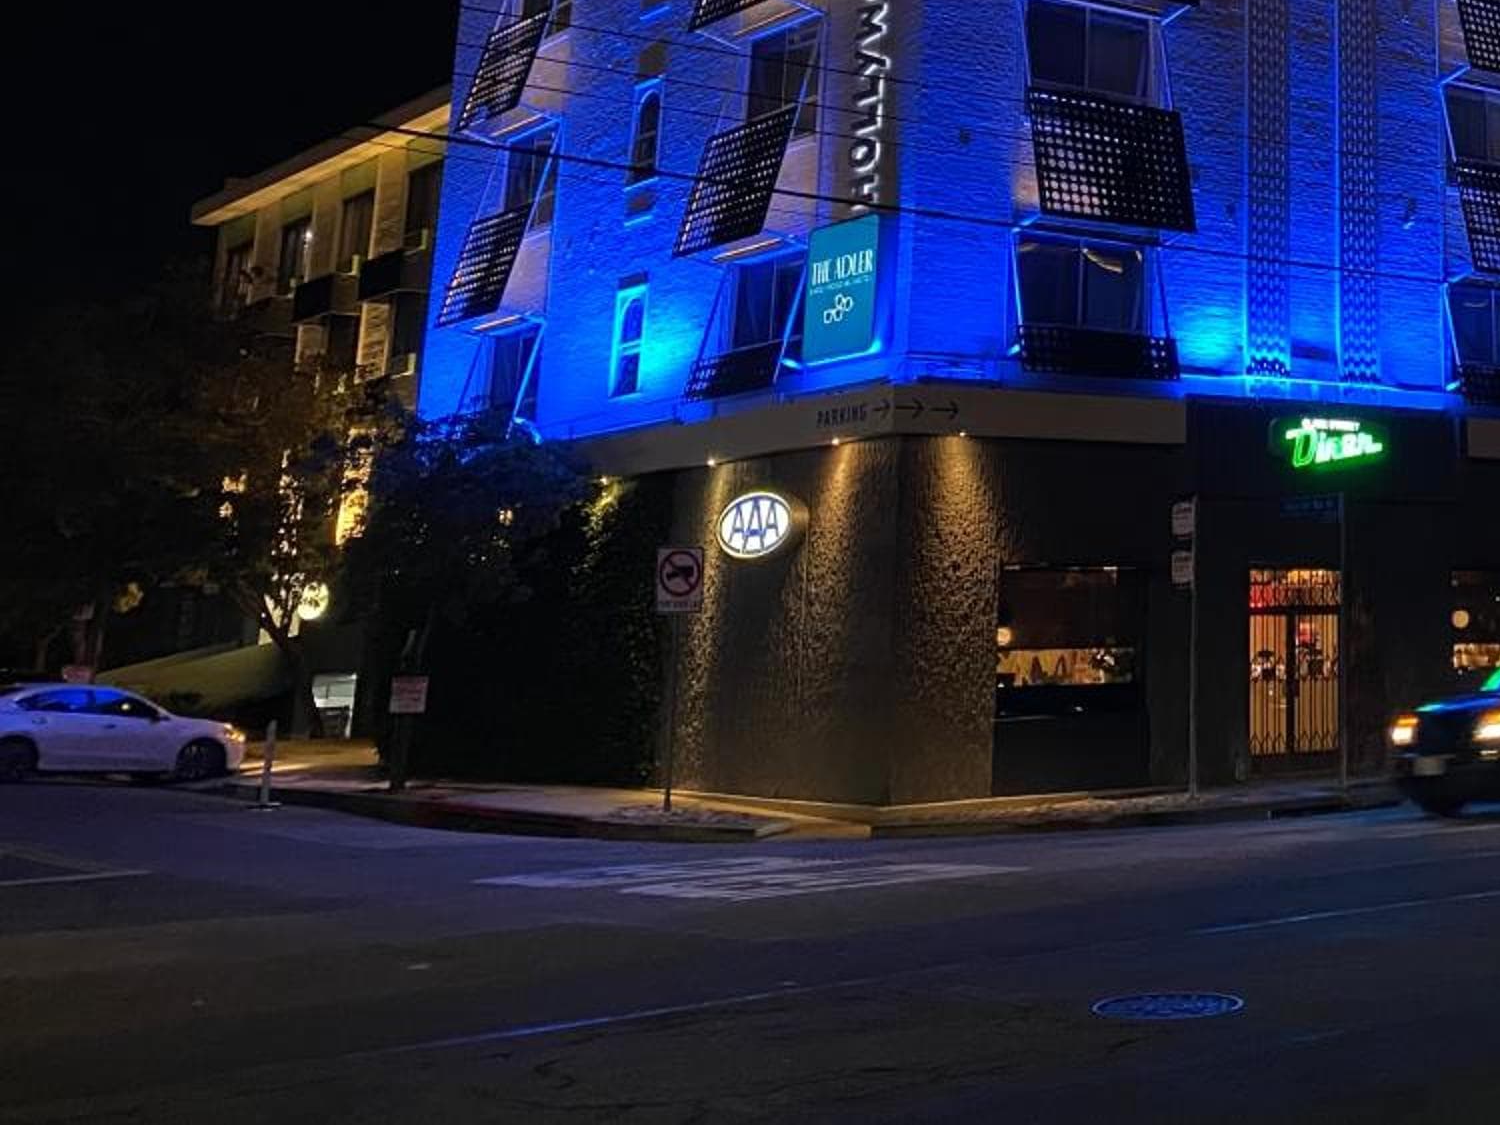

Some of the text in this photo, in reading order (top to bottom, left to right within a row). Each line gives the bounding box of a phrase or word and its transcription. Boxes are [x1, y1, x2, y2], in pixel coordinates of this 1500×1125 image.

[834, 248, 873, 280] ADLER
[816, 405, 866, 427] PARKING
[728, 496, 780, 554] AAA
